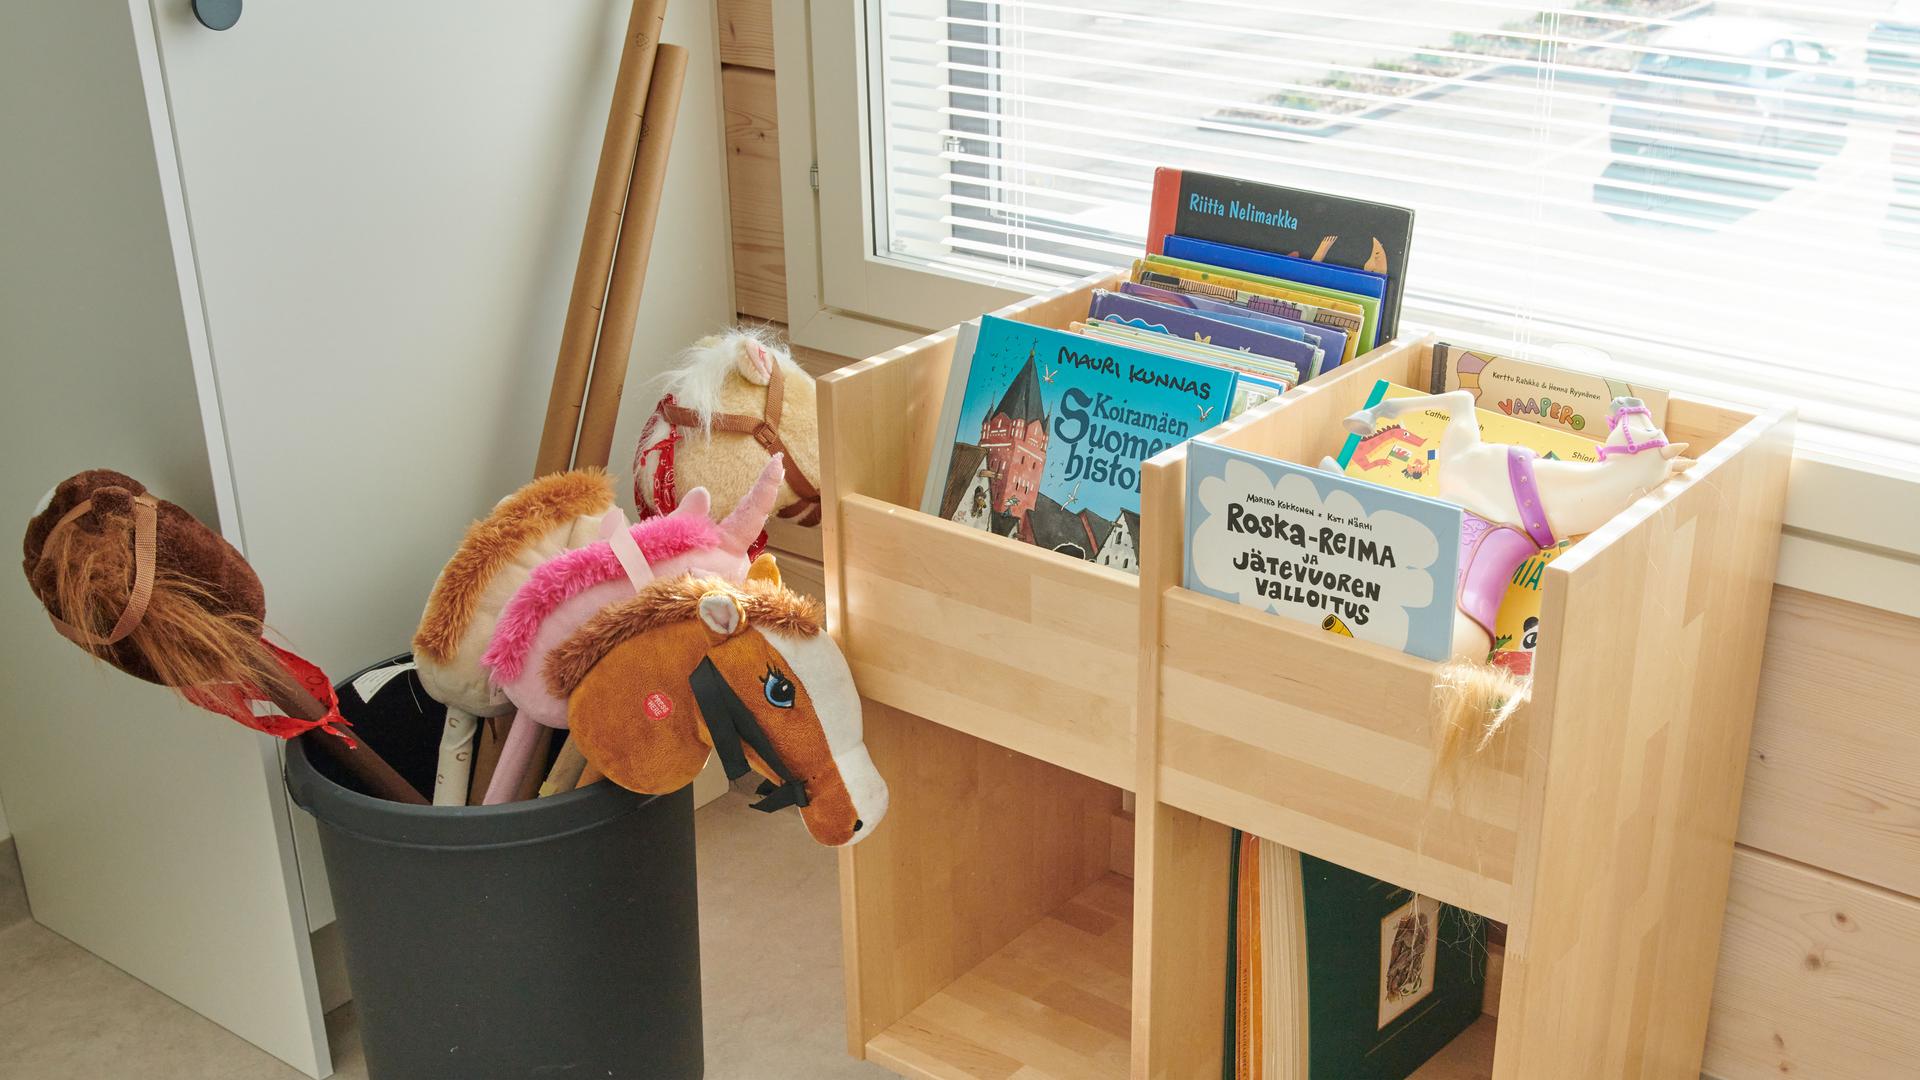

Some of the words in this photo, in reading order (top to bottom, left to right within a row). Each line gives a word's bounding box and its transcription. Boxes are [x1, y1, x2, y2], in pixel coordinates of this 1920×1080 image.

[1189, 193, 1225, 217] Riitta
[1229, 201, 1298, 231] Nelimarkka
[1057, 346, 1121, 379] MAURI
[1129, 363, 1211, 400] KUNNAS
[1492, 371, 1514, 382] Kerttu
[1548, 383, 1568, 394] Henna
[1092, 392, 1189, 438] Koiramäen
[1497, 397, 1586, 431] VAAPERO
